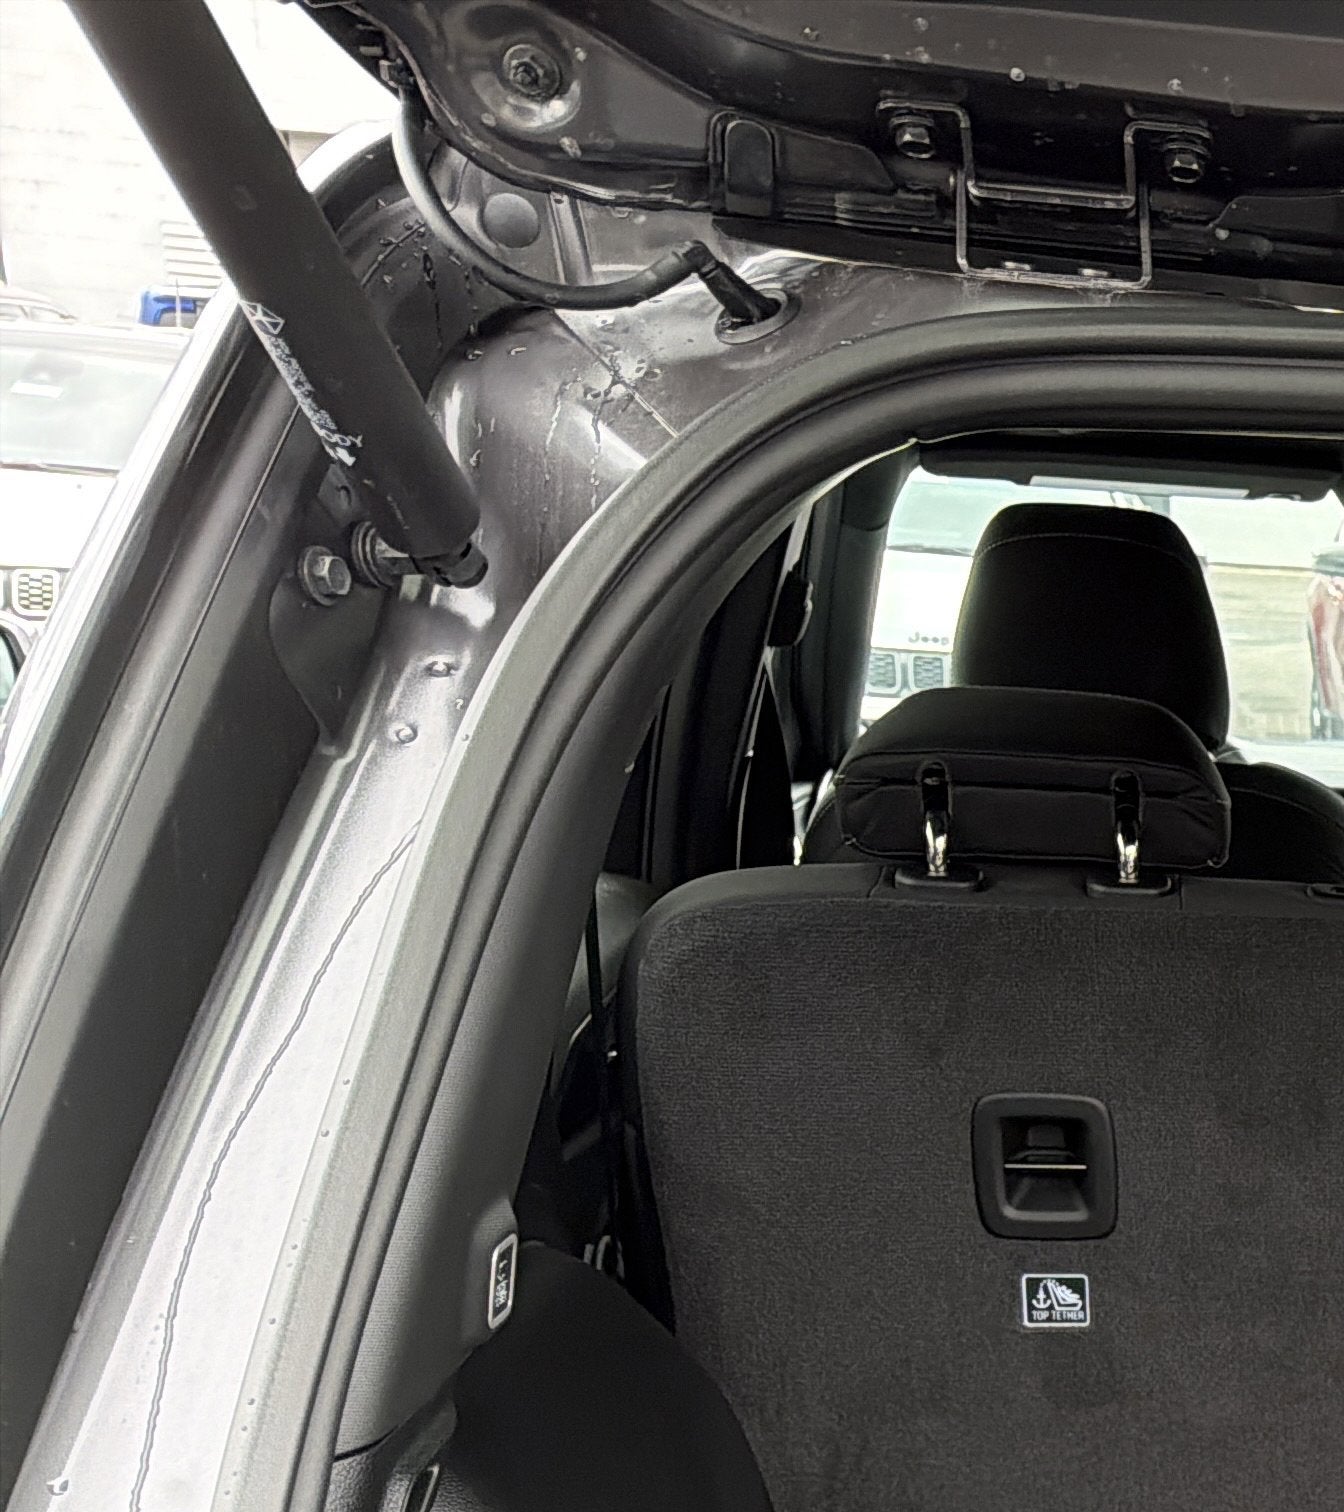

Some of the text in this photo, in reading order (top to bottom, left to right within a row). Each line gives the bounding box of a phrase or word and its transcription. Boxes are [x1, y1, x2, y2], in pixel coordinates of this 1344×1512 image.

[908, 631, 950, 646] Jeep
[1031, 1310, 1085, 1321] TOP TETHER
